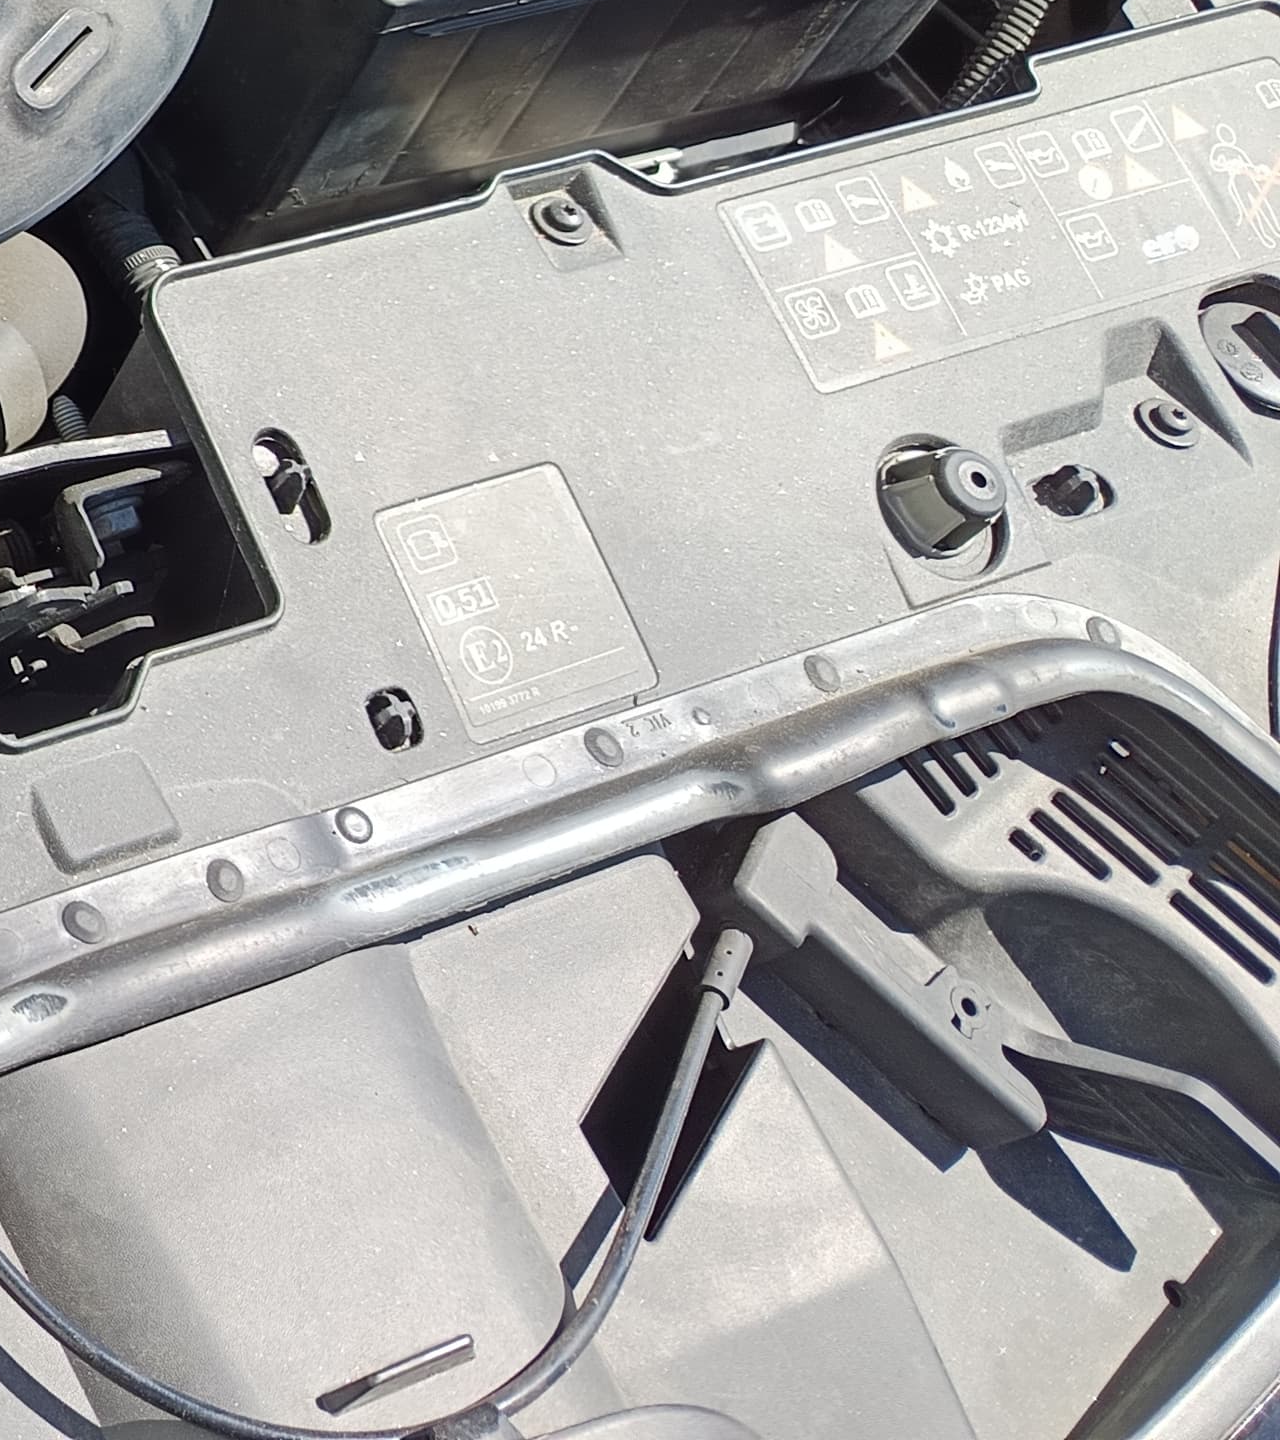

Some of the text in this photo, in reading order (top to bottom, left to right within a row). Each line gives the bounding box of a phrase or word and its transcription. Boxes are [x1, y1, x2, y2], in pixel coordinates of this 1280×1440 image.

[990, 268, 1032, 293] PAG
[435, 582, 493, 619] 0,51
[520, 626, 548, 652] 24
[466, 639, 508, 673] E2
